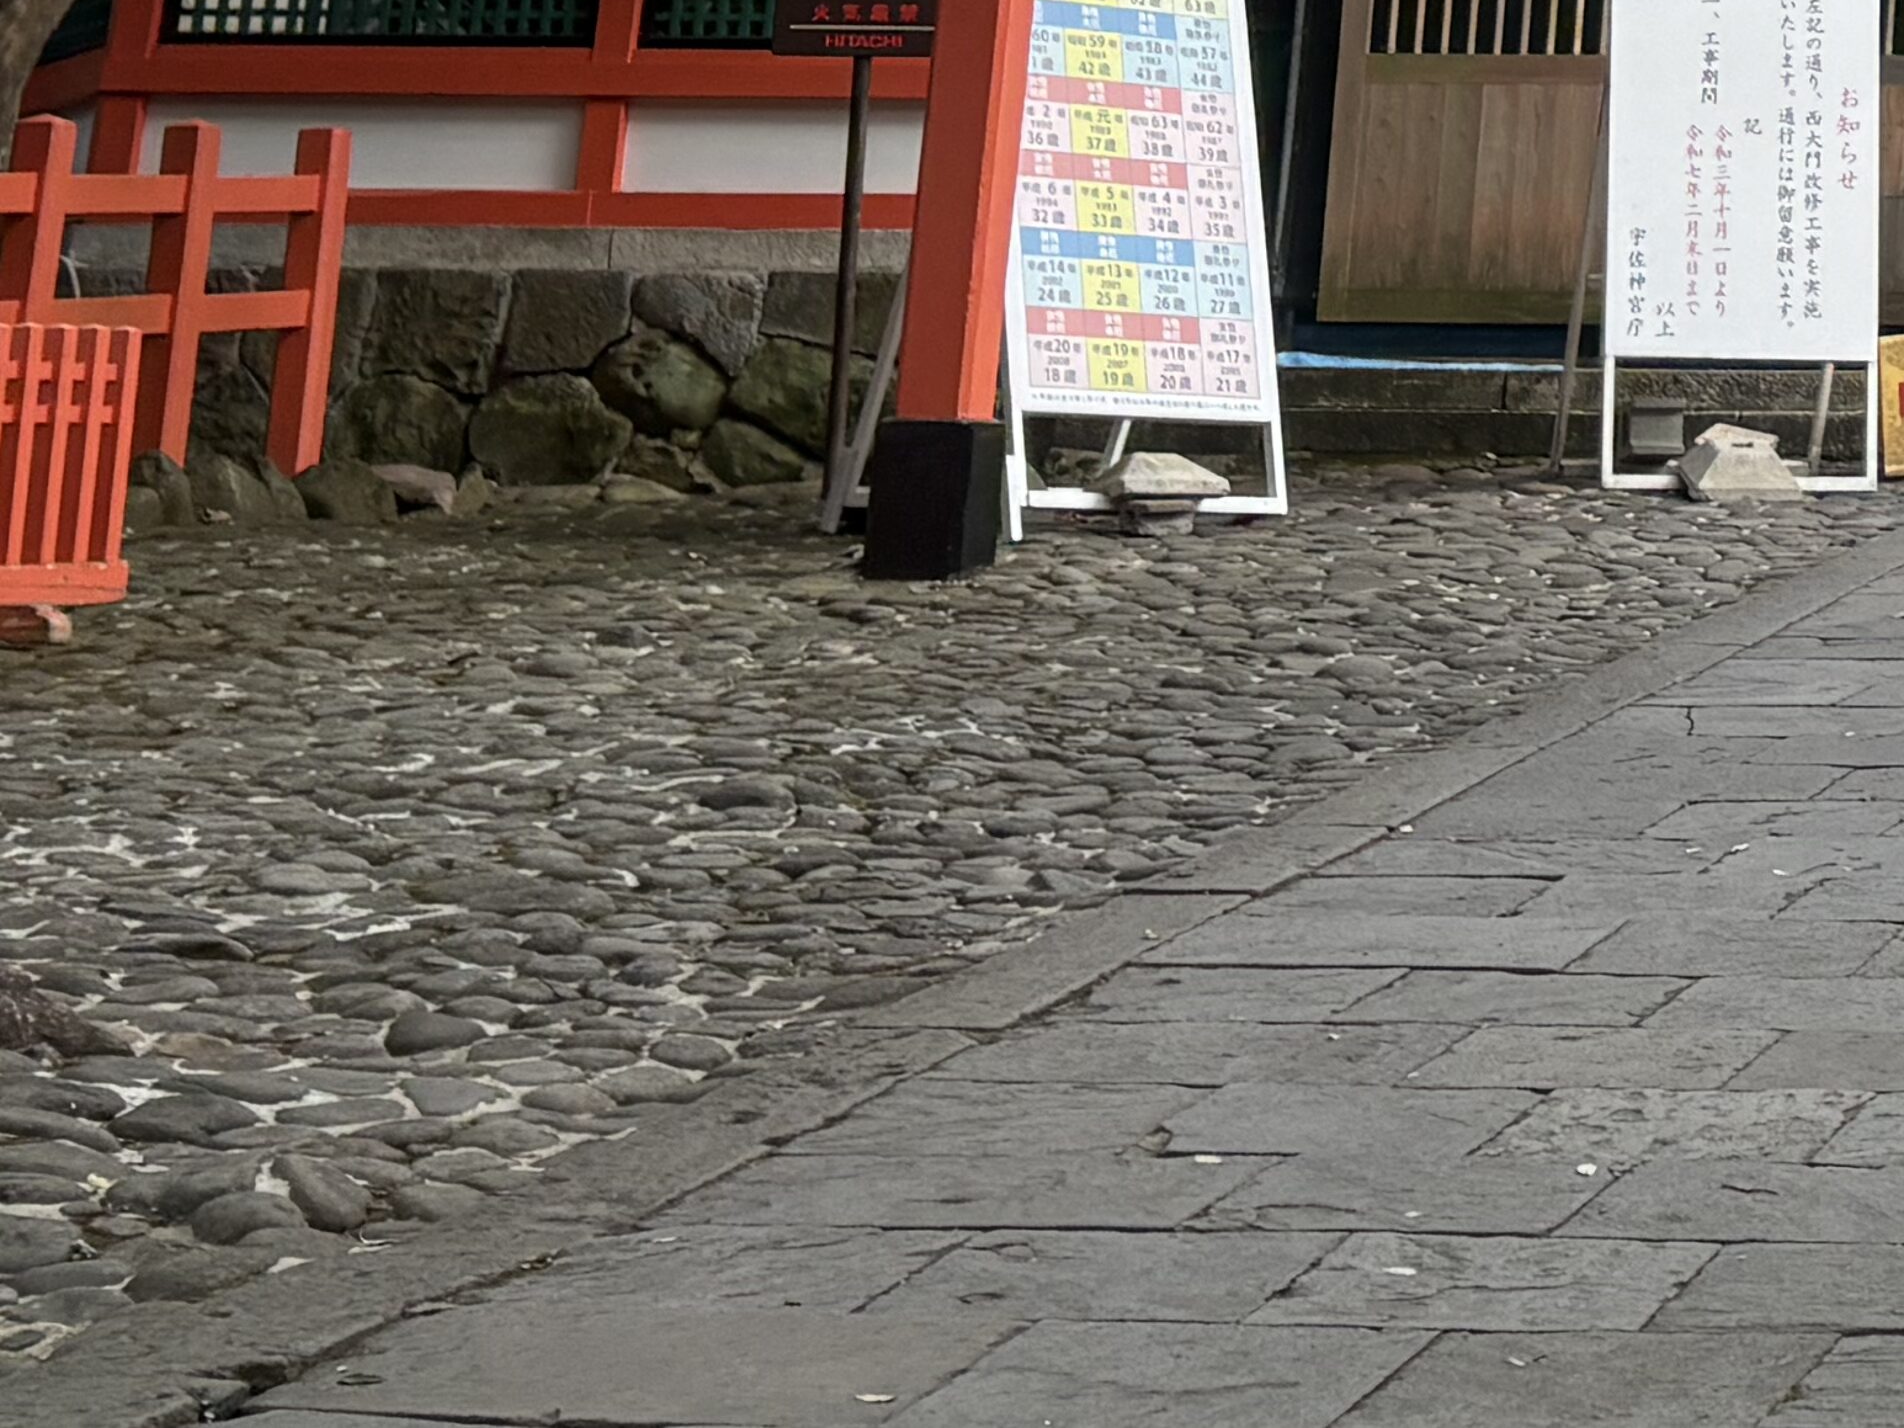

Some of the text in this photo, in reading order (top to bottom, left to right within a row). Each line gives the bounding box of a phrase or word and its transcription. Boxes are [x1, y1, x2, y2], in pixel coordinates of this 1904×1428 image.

[825, 35, 903, 48] HITACHI
[1743, 118, 1763, 135] 記
[1836, 87, 1861, 190] お知らせ
[1655, 302, 1675, 337] 以上
